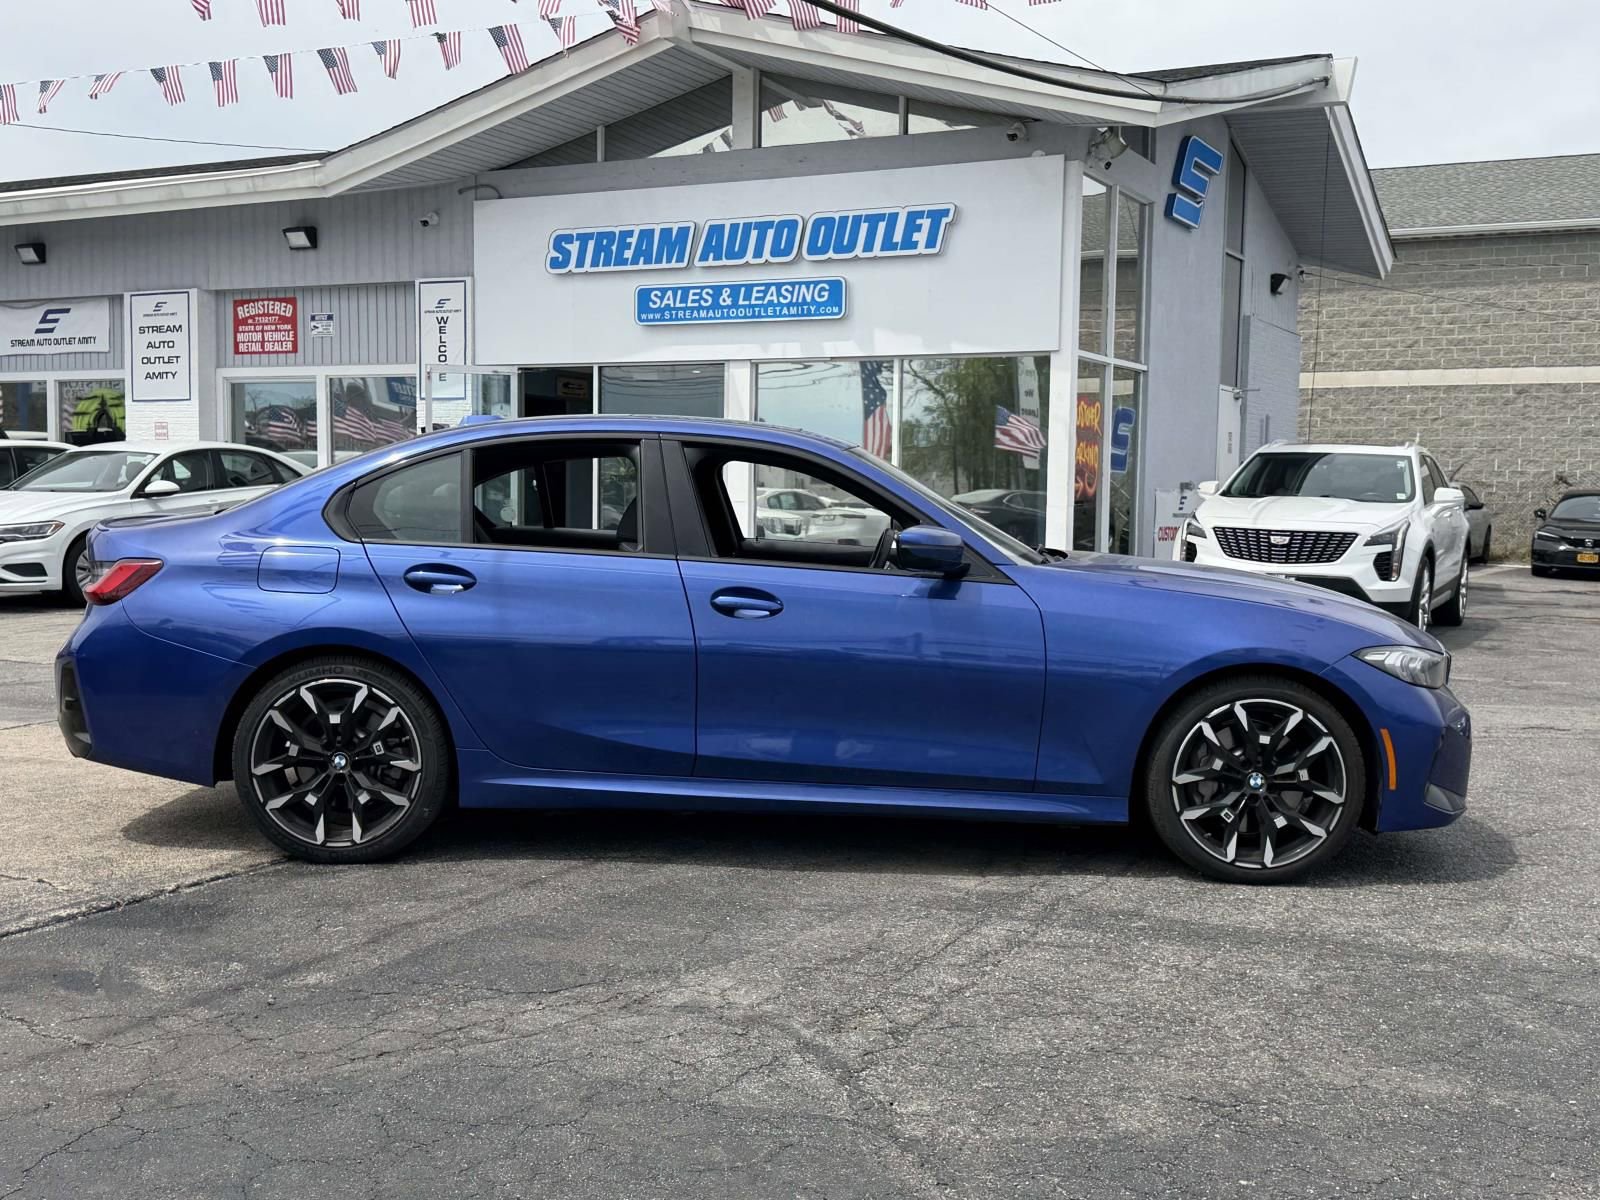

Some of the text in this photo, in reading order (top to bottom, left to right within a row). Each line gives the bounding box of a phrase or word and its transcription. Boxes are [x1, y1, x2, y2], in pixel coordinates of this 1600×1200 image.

[550, 208, 951, 270] STREAM AUTO OUTLET
[648, 283, 830, 309] SALES & LEASING
[237, 300, 293, 320] REGISTERED
[138, 324, 183, 335] STREAM
[10, 335, 97, 348] STREAM AUTO OUTLET AMITY
[236, 331, 295, 343] MOTOR VEHICLE
[146, 340, 175, 349] AUTO
[238, 342, 293, 353] RETAIL DEALER
[436, 316, 449, 381] WELCOE
[141, 356, 181, 365] OUTLET
[144, 371, 178, 381] AMITY
